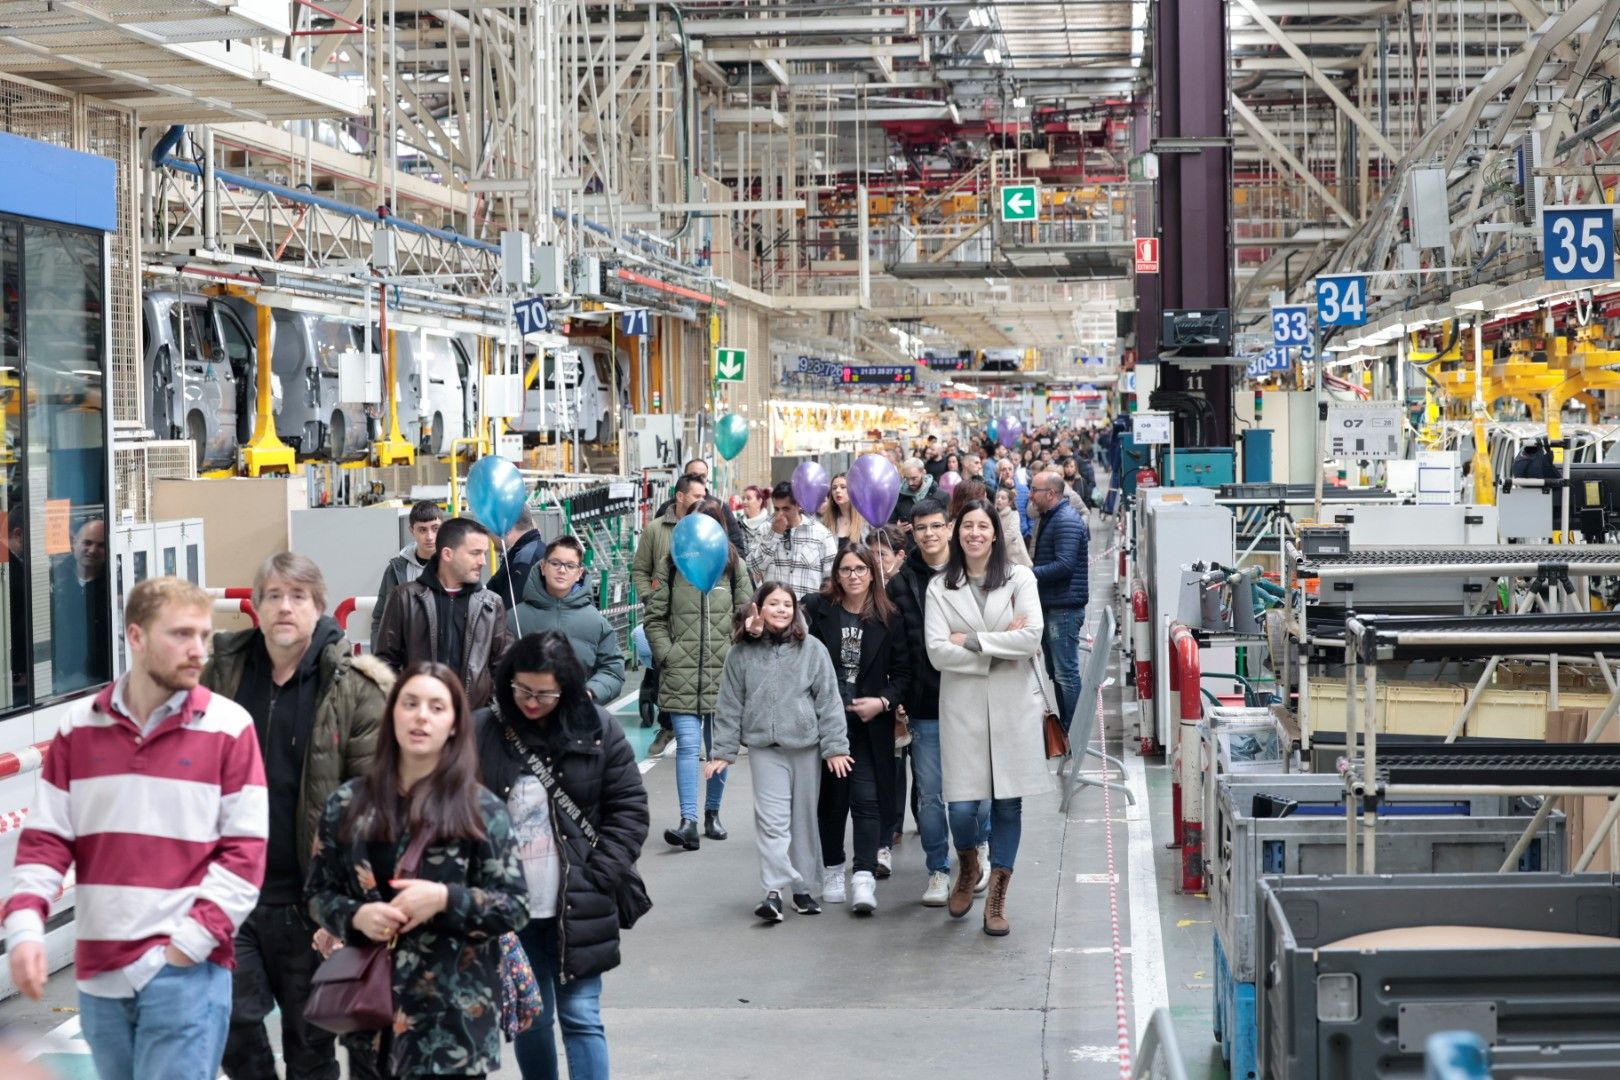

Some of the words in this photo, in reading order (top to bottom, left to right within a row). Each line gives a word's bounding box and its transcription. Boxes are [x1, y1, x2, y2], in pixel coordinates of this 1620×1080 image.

[1552, 217, 1606, 274] 35
[1319, 280, 1364, 322] 34
[515, 301, 548, 333] 70
[623, 309, 649, 335] 71
[1274, 311, 1308, 341] 33
[1247, 356, 1267, 375] 30
[1266, 345, 1288, 368] 31
[1186, 375, 1204, 390] 11
[1343, 419, 1364, 428] 07
[527, 753, 556, 789] BIMBA
[552, 786, 582, 821] BIMBA
